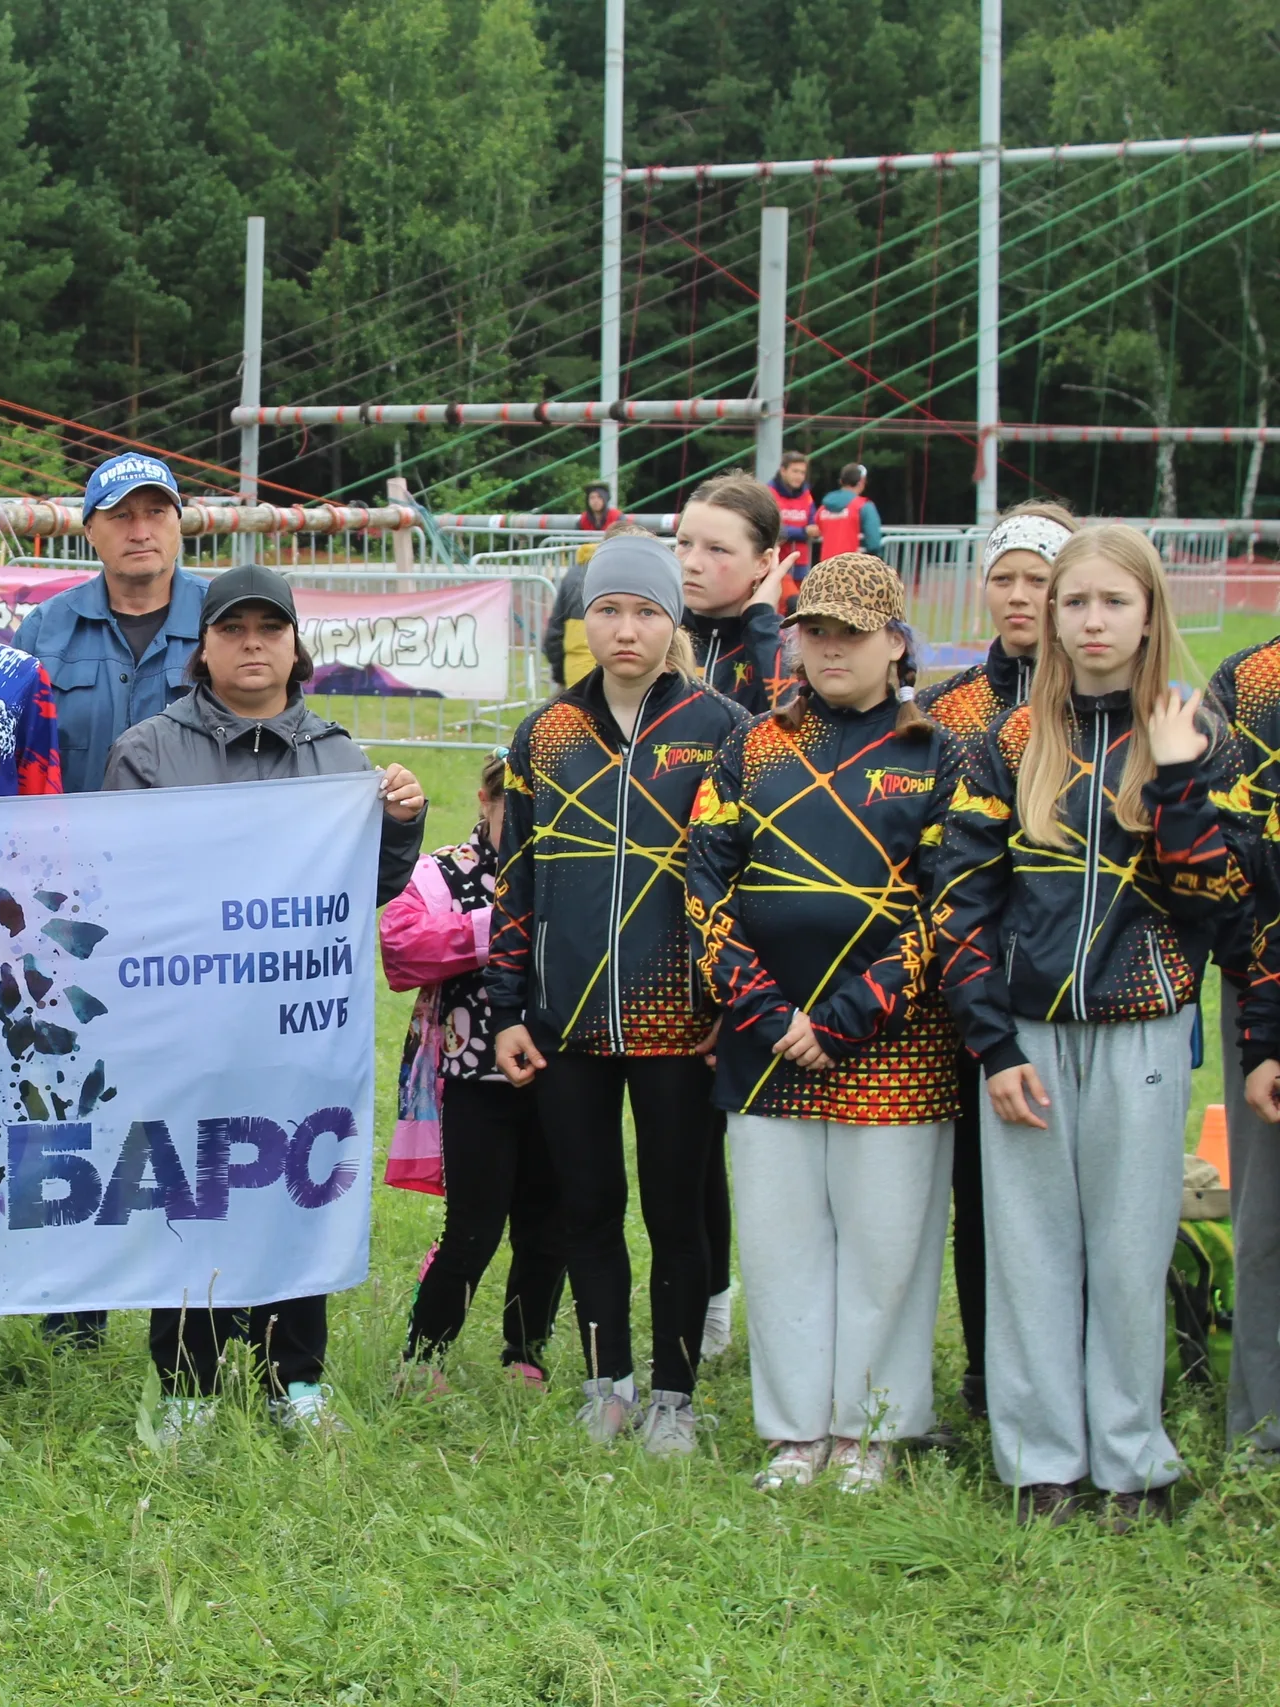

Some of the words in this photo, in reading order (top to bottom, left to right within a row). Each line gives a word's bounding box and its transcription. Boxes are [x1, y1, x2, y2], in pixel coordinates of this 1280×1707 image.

[99, 461, 168, 488] BUDAPEST
[667, 747, 713, 766] ПРОРЫВ
[221, 891, 350, 931] ВОЕННО
[118, 936, 353, 988] СПОРТИВНЫЙ
[279, 996, 350, 1035] КЛУБ
[7, 1106, 360, 1231] БАРС
